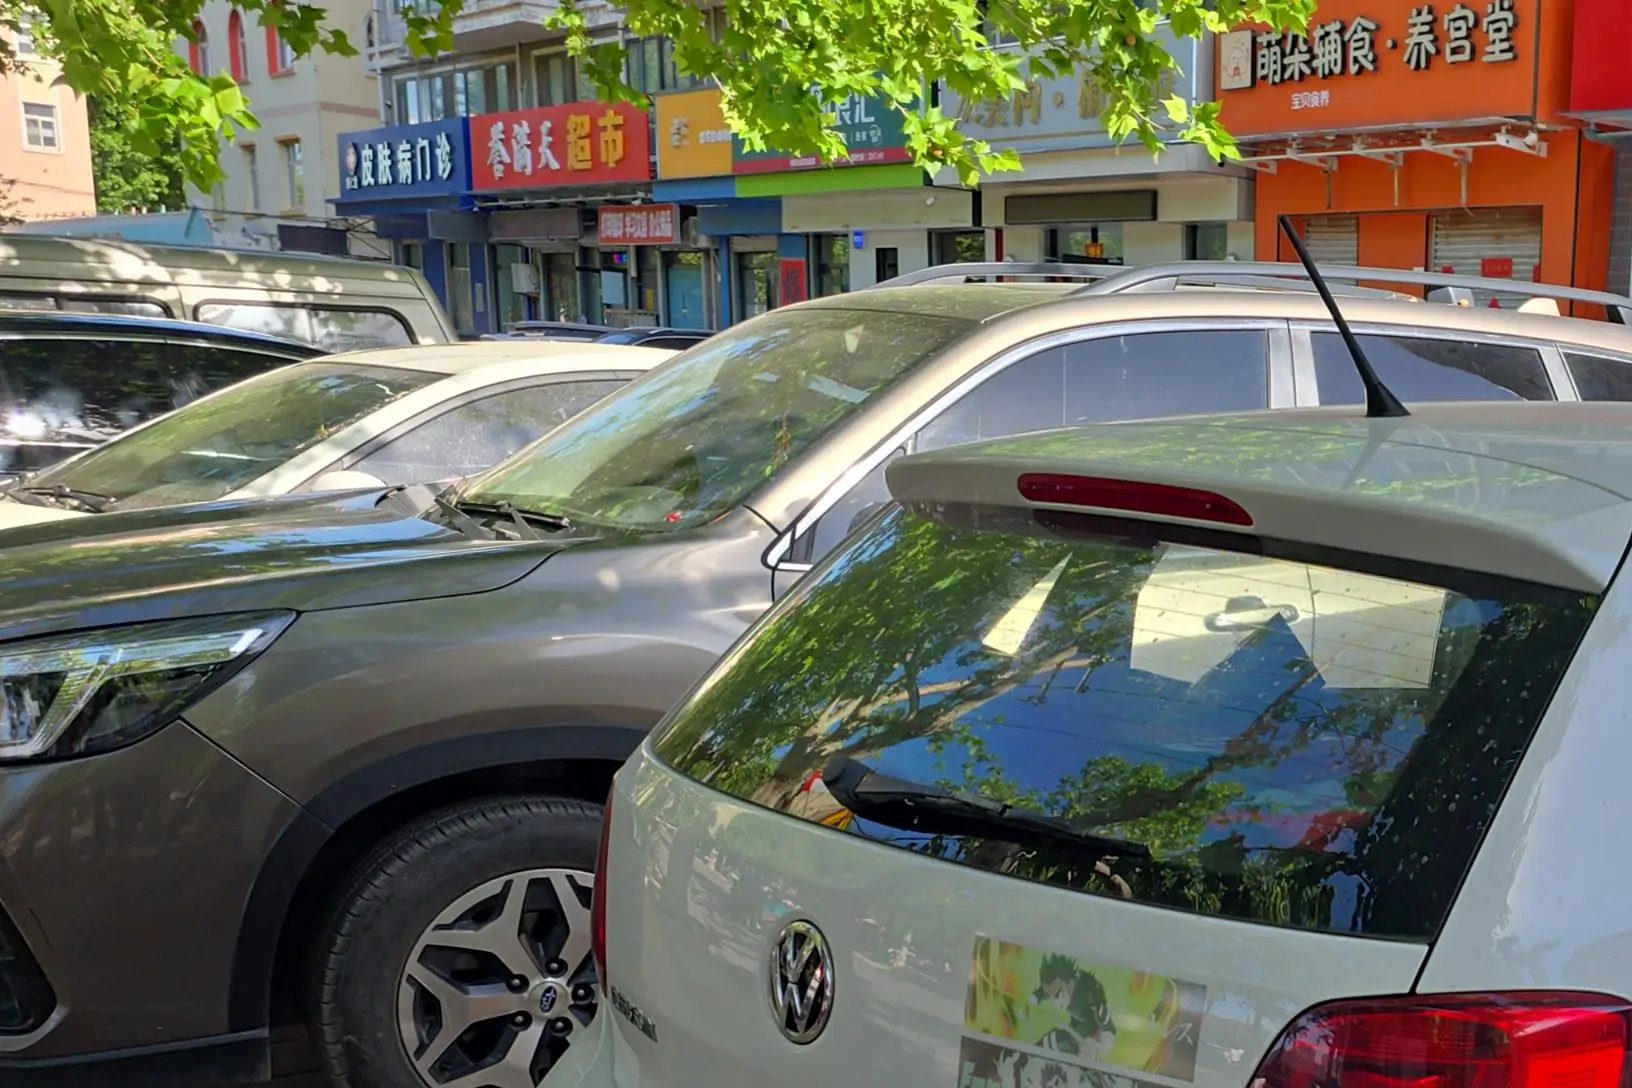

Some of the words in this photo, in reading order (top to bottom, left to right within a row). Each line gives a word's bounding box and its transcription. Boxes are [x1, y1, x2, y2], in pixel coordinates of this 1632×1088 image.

[360, 131, 452, 186] 皮肤病门诊
